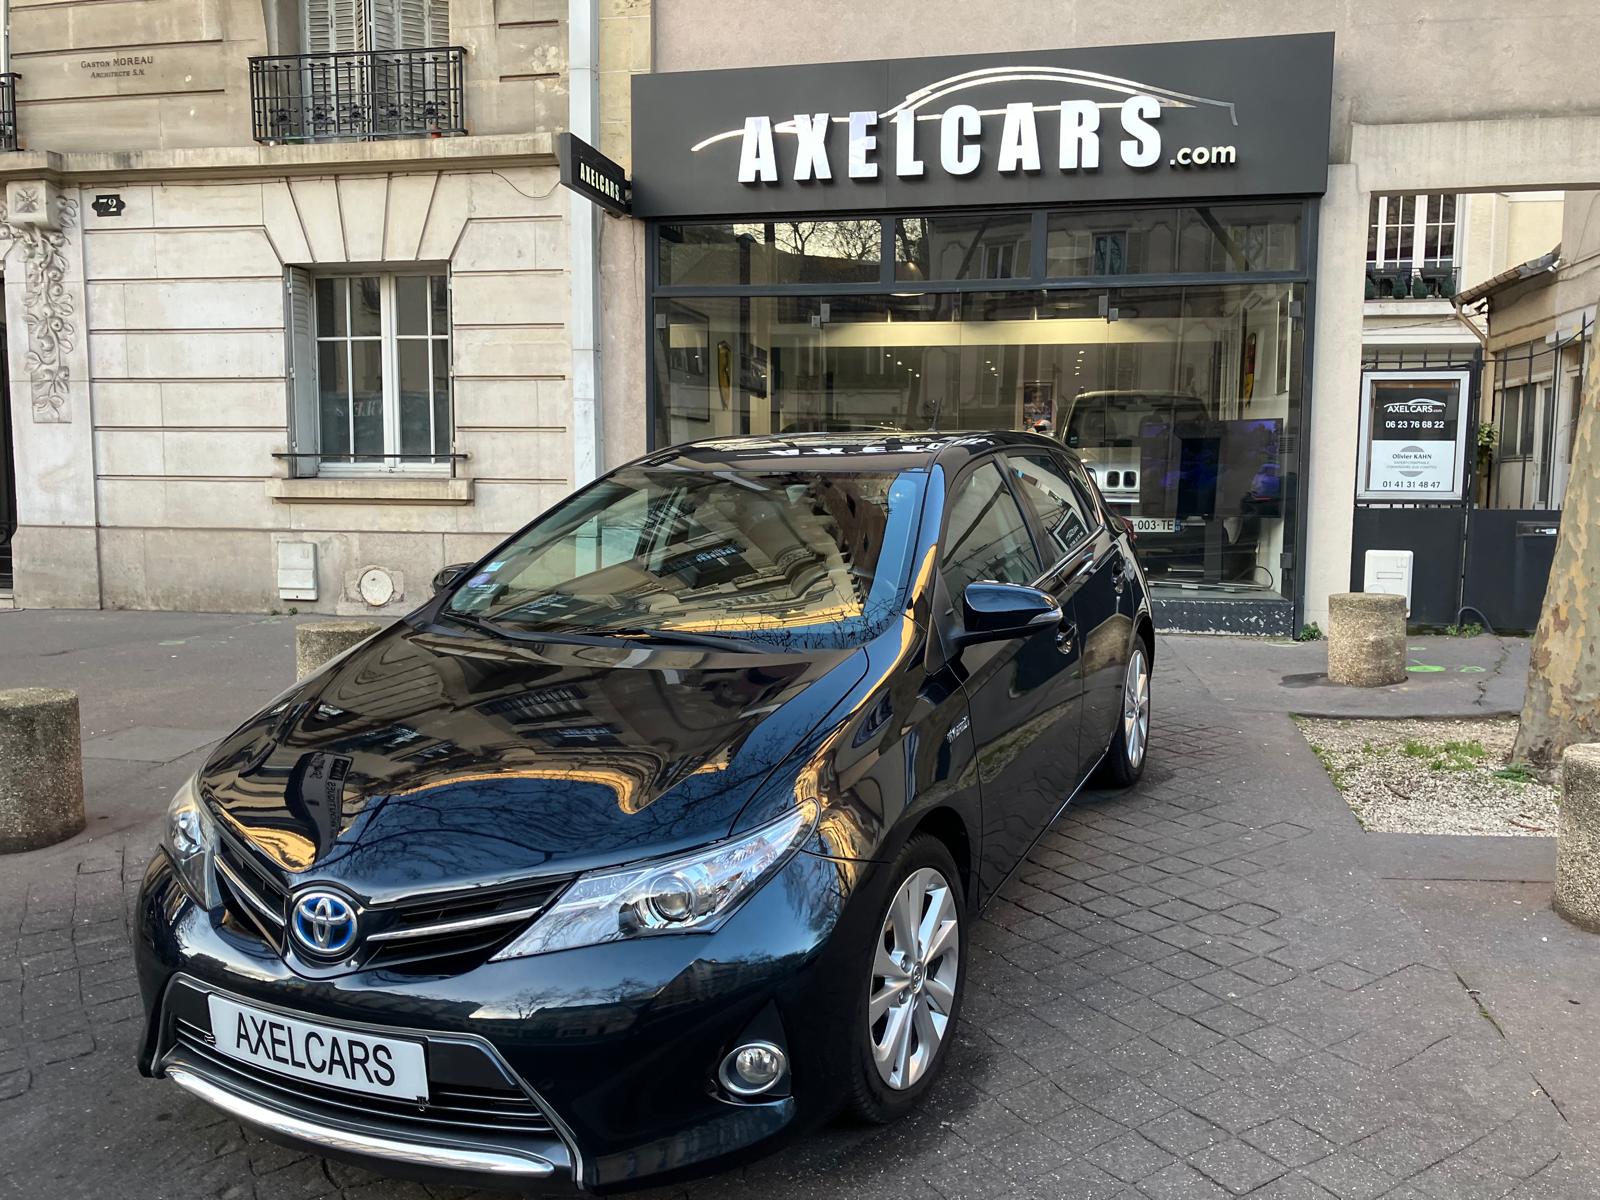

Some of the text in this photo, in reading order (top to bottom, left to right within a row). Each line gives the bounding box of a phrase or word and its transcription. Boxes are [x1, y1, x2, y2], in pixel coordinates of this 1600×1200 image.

[113, 57, 153, 66] MOREAU
[580, 161, 620, 202] AXELCARS
[236, 1012, 396, 1087] AXELCARS
